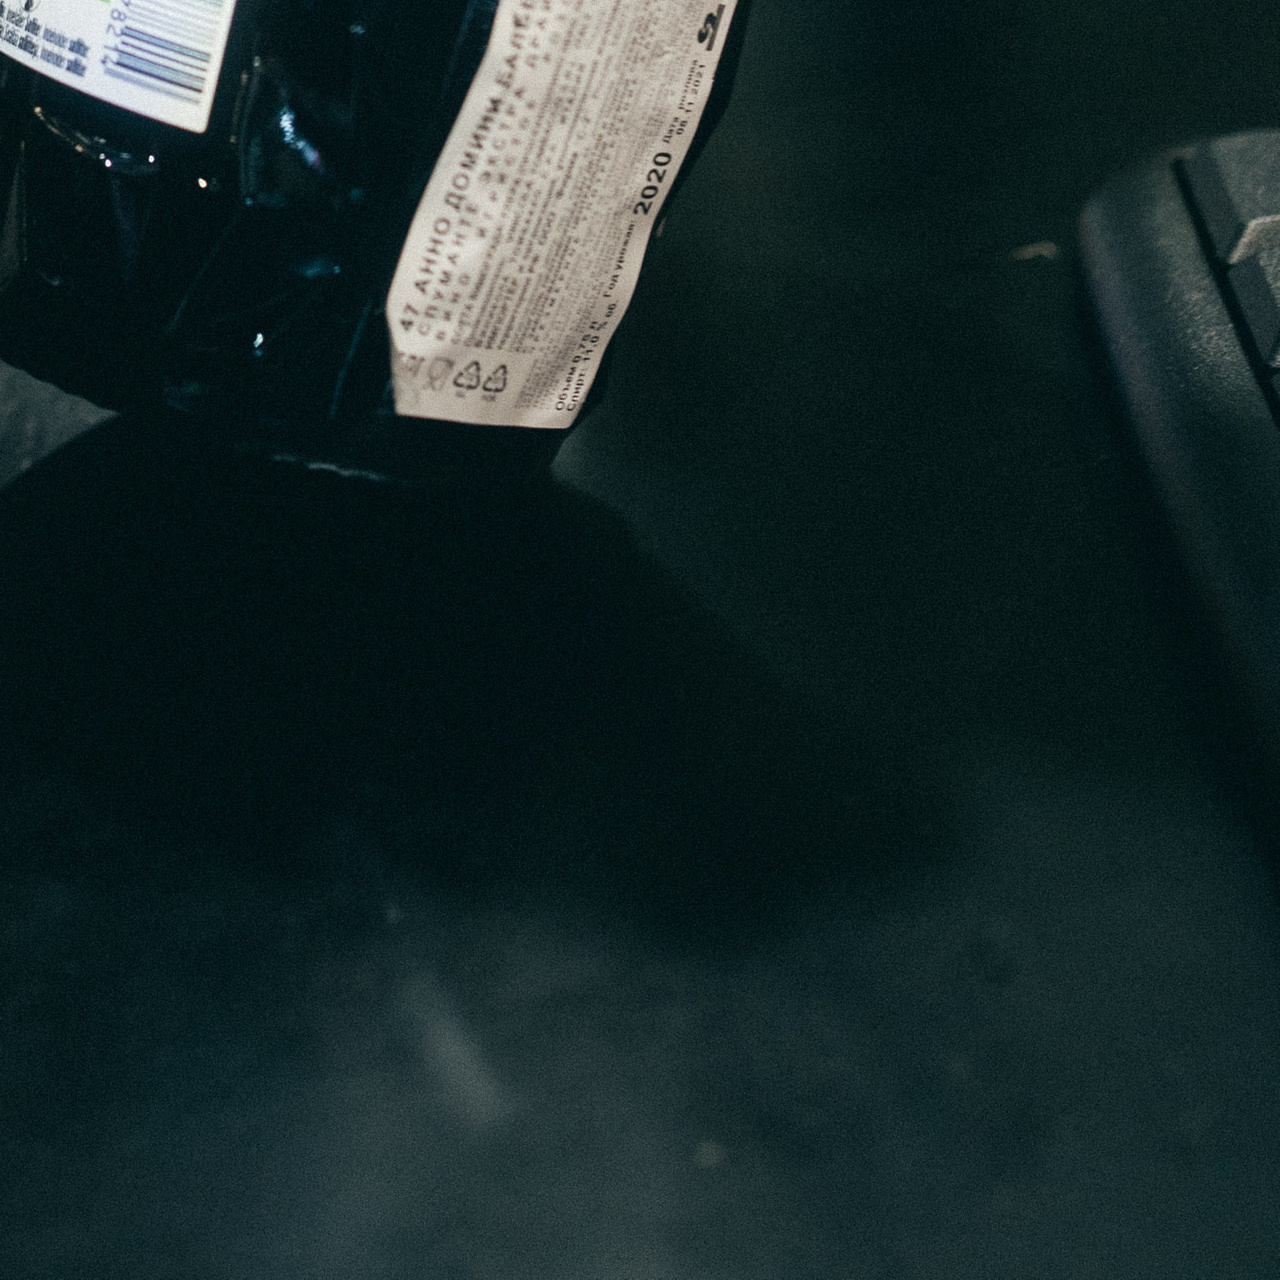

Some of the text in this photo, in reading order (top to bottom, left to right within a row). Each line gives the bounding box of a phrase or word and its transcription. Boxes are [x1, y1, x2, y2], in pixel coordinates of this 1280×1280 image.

[631, 148, 673, 218] 2020
[398, 302, 419, 332] 47
[409, 214, 453, 295] АННО
